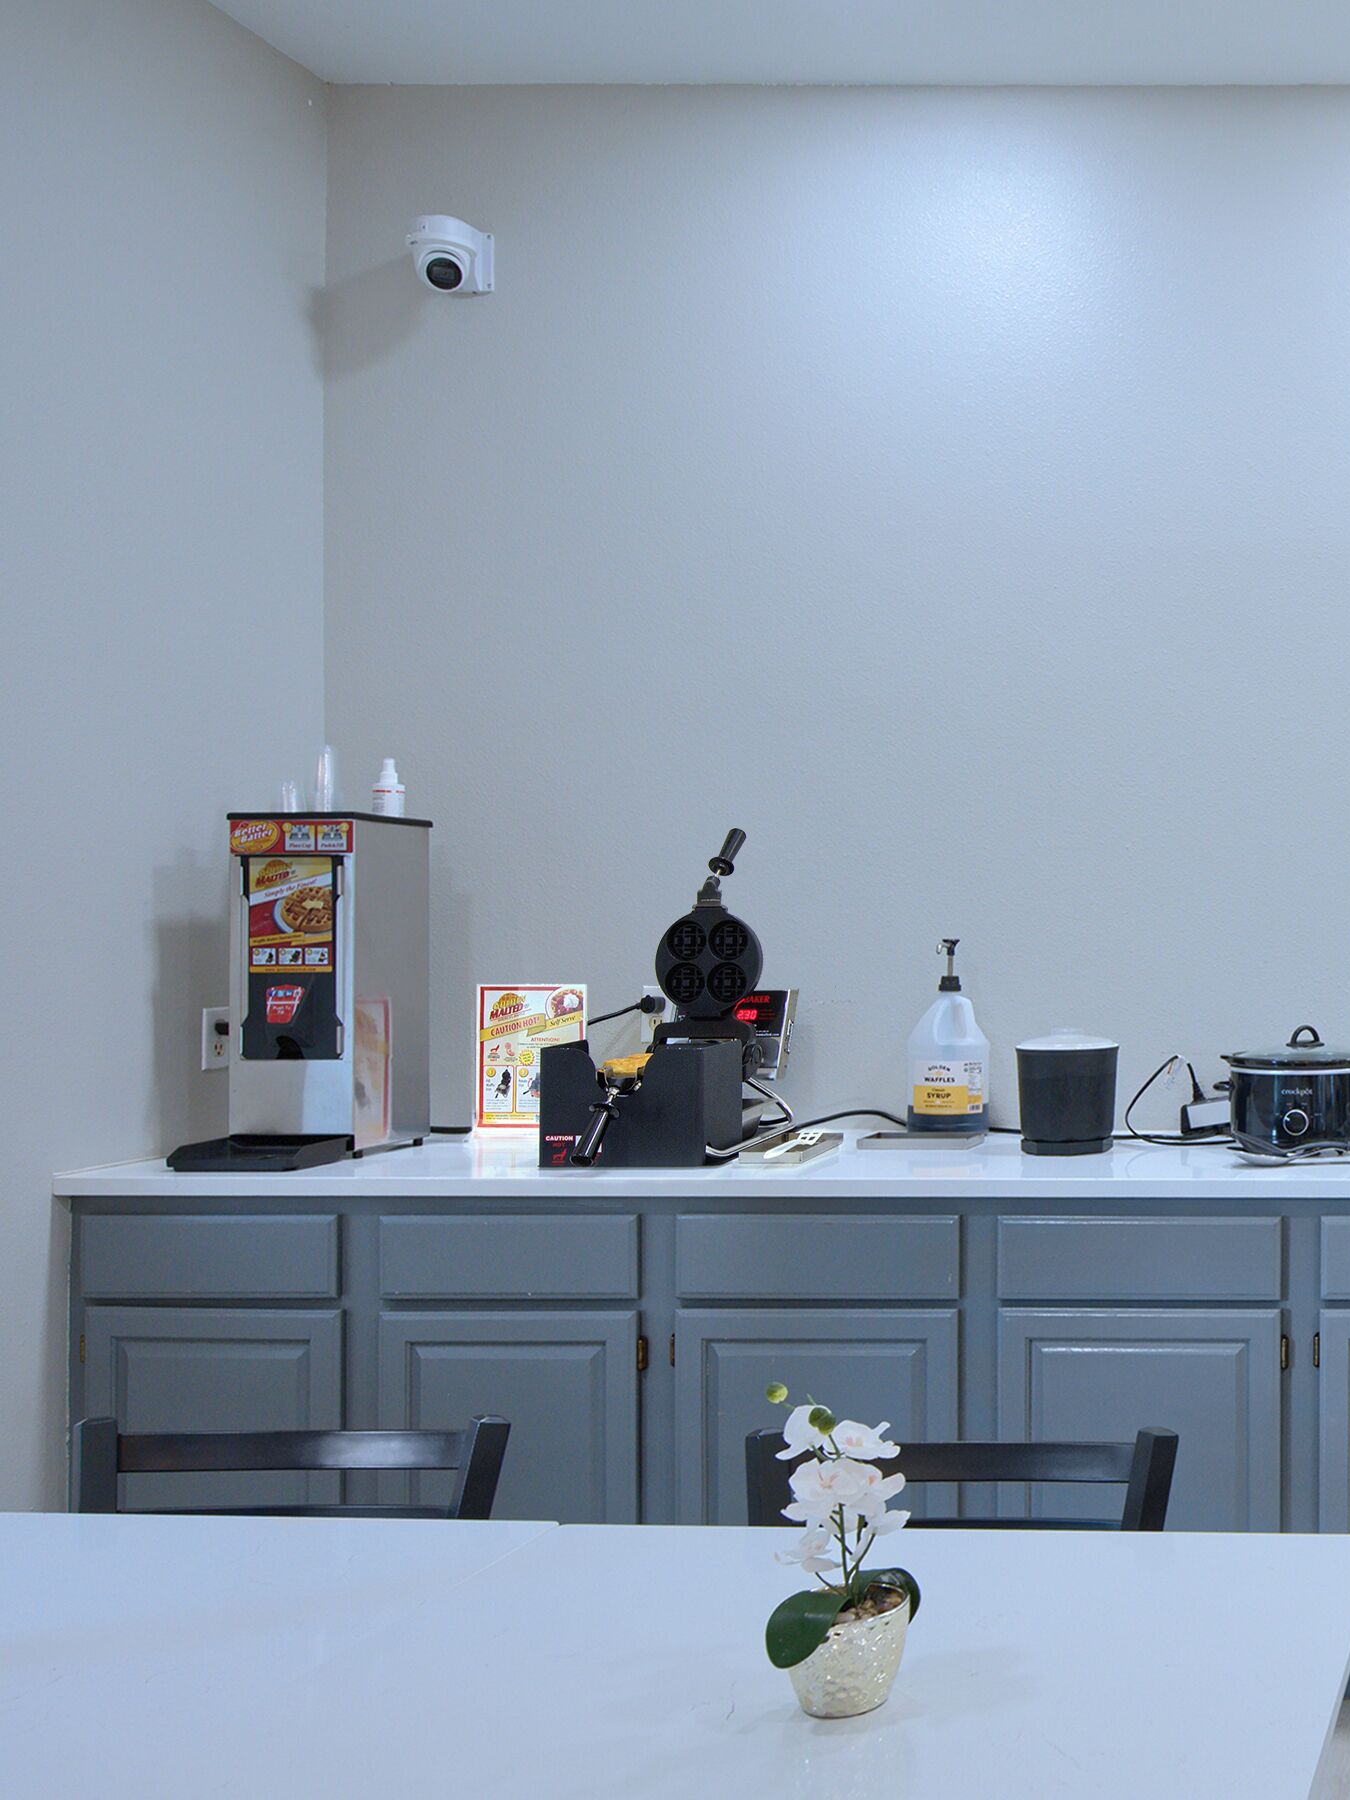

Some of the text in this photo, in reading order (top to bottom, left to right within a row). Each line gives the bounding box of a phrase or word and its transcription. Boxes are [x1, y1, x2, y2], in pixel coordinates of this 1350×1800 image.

[489, 1002, 524, 1020] MALTED
[490, 1016, 540, 1036] CAUTION HOT!
[550, 1015, 576, 1027] Self Serve
